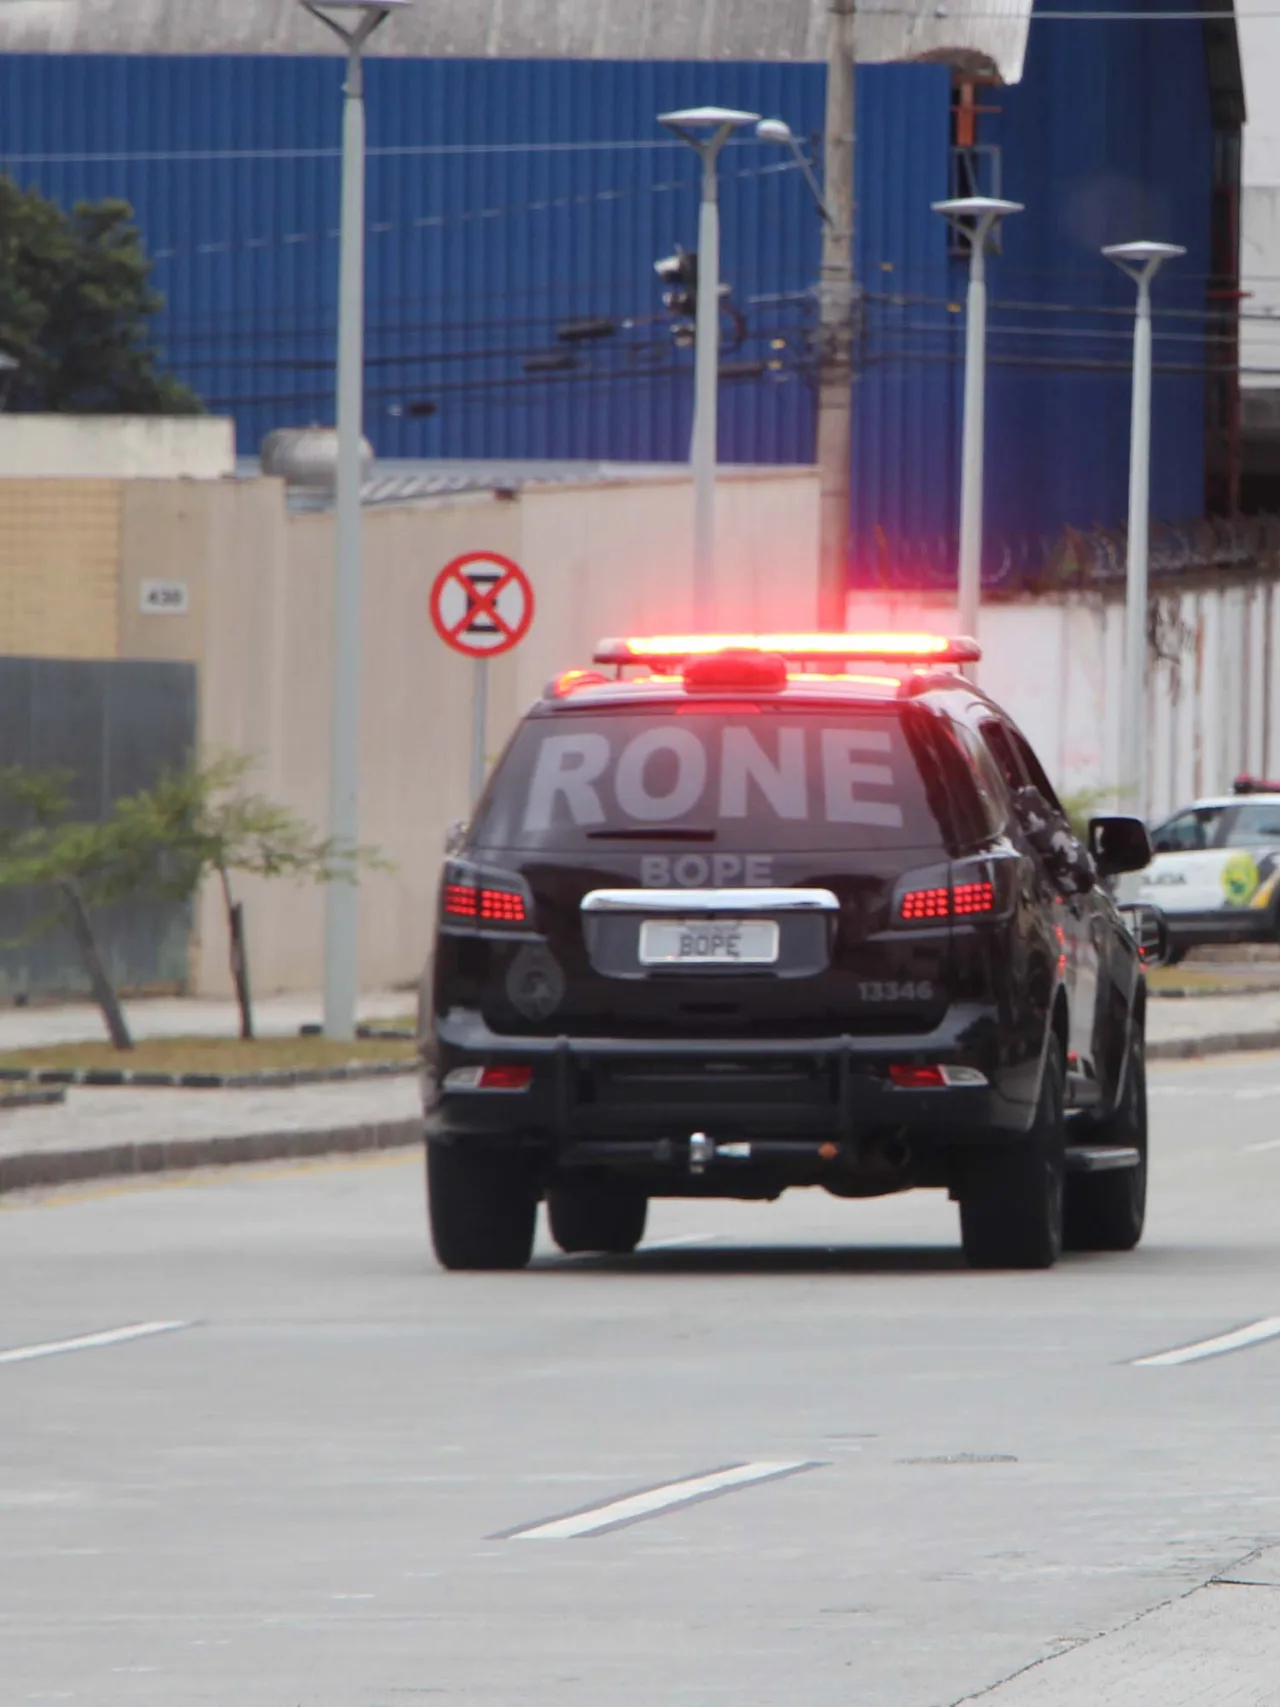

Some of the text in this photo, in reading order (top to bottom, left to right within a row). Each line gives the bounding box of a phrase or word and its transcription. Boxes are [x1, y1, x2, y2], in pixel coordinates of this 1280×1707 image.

[523, 726, 902, 832] RONE
[641, 853, 773, 888] BOPE
[679, 934, 741, 957] BOPE
